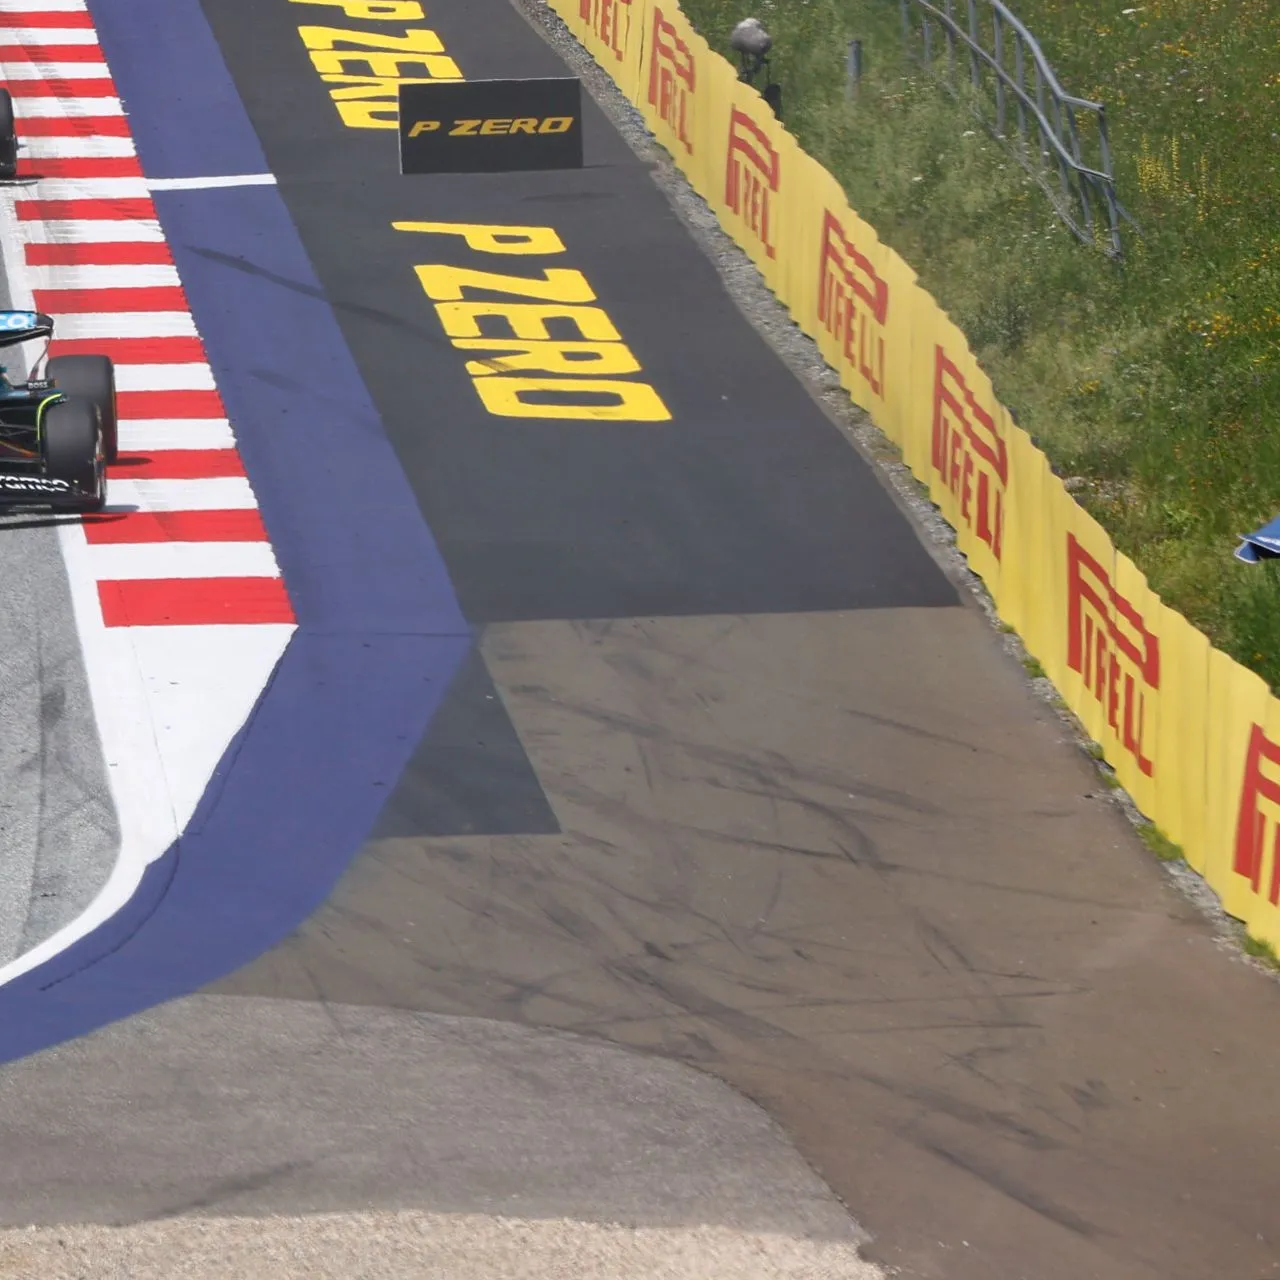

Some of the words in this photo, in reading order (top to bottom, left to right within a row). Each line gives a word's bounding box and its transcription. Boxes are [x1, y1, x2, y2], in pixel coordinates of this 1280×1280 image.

[408, 120, 441, 137] P
[448, 117, 574, 137] ZERO
[391, 221, 567, 255] P
[413, 263, 673, 421] ZERO
[1066, 530, 1162, 779] PIRELL
